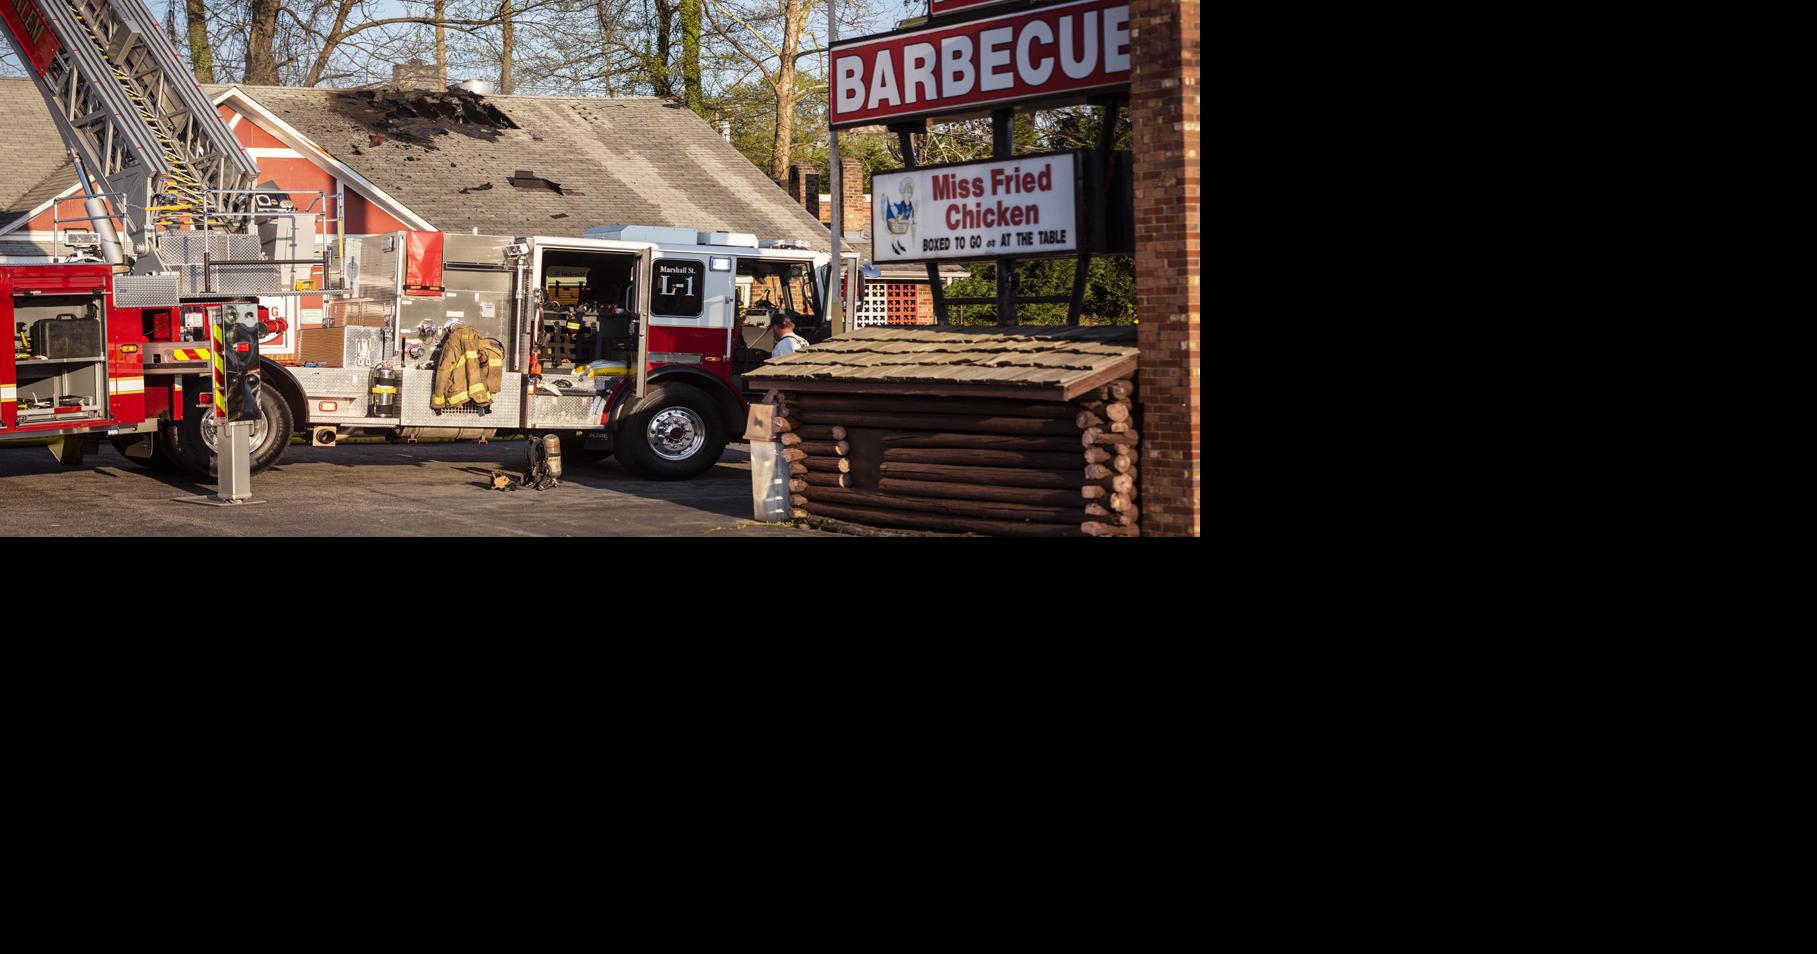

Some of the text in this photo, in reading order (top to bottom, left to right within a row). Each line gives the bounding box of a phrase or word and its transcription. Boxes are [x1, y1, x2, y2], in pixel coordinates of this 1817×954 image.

[836, 5, 1131, 114] BARBECUE
[931, 163, 1053, 201] Miss Fried
[945, 200, 1039, 231] Chicken
[922, 238, 950, 252] BOXED
[954, 236, 966, 250] TO
[969, 235, 982, 249] GO
[1000, 233, 1012, 247] AT
[1016, 232, 1034, 246] THE
[1038, 229, 1067, 245] TABLE
[660, 265, 696, 274] Marshall St.
[660, 275, 695, 296] L-1
